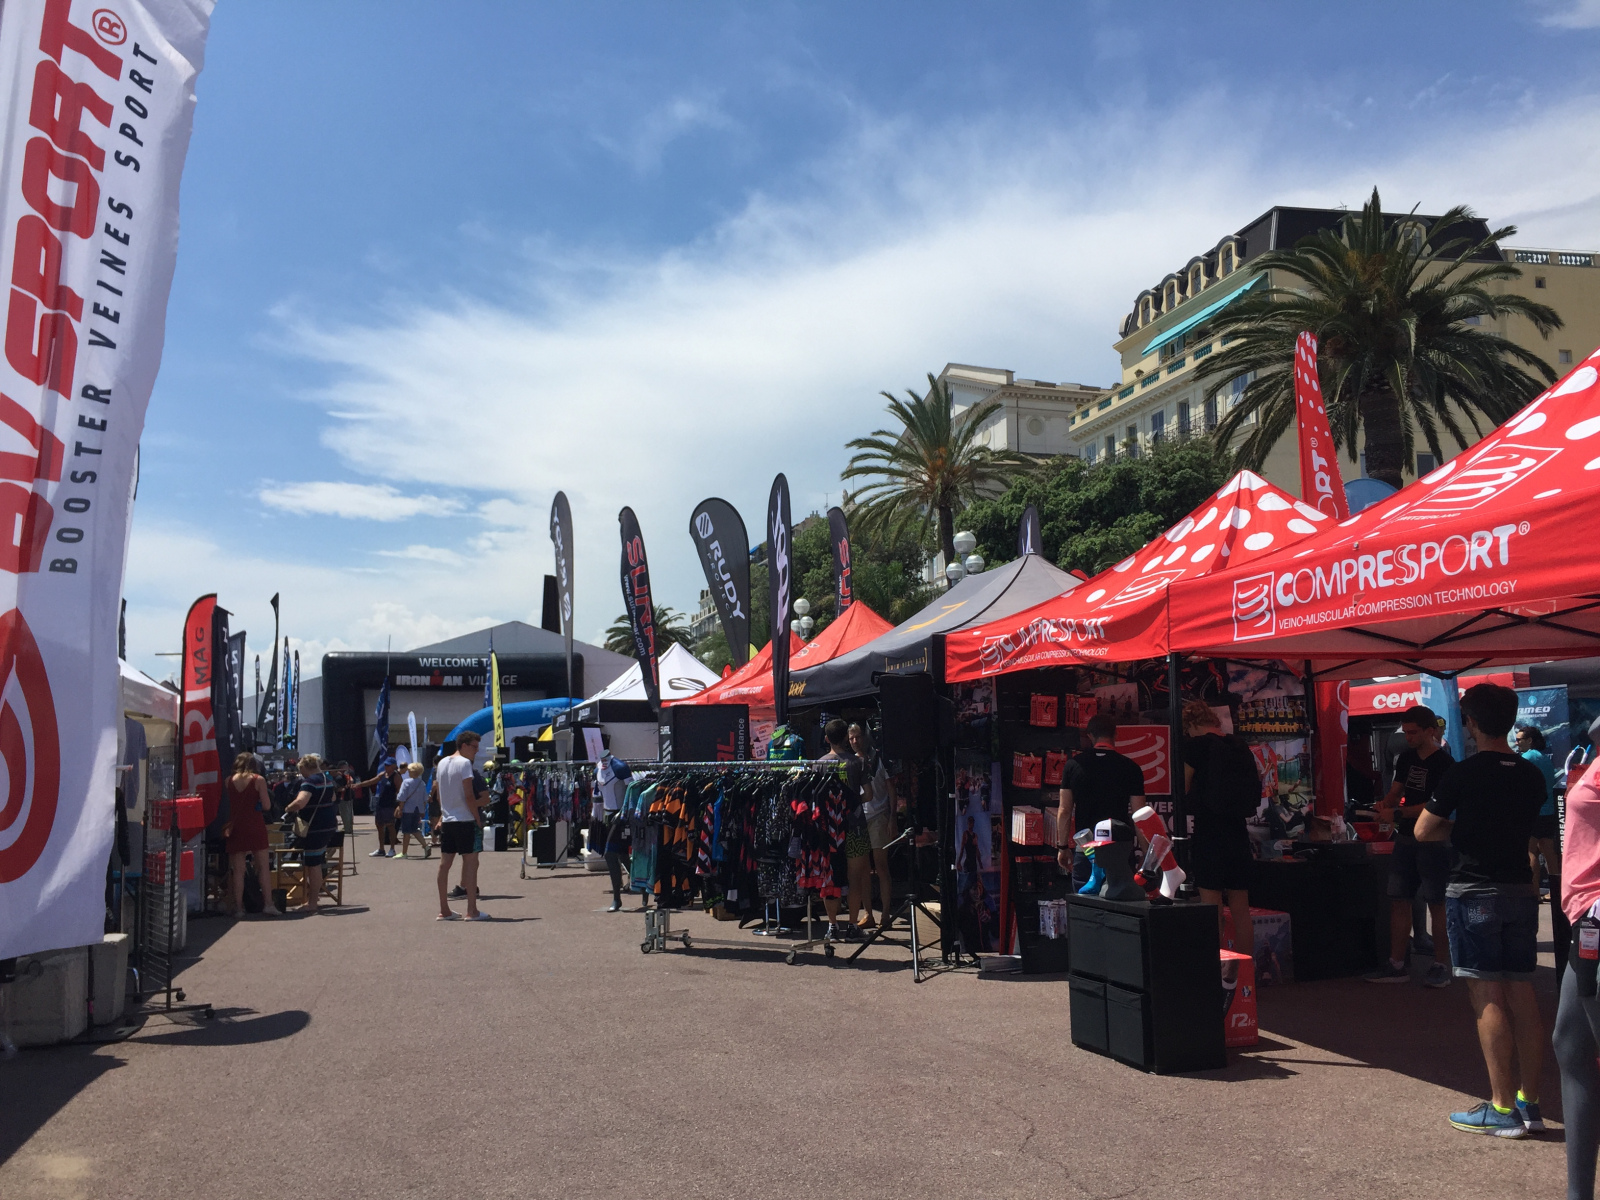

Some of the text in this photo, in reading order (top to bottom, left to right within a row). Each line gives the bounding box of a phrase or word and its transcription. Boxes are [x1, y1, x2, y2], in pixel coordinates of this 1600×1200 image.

[49, 42, 158, 575] BOOSTER VEINES SPORT
[707, 552, 734, 619] PROJECT
[709, 540, 746, 620] RUDY
[1278, 579, 1517, 630] VEINO-MUSCULAR COMPRESSION TECHNOLOGY
[396, 671, 518, 686] IRONMAN VILGE
[419, 657, 490, 668] WELCOME T
[737, 718, 745, 760] Distance
